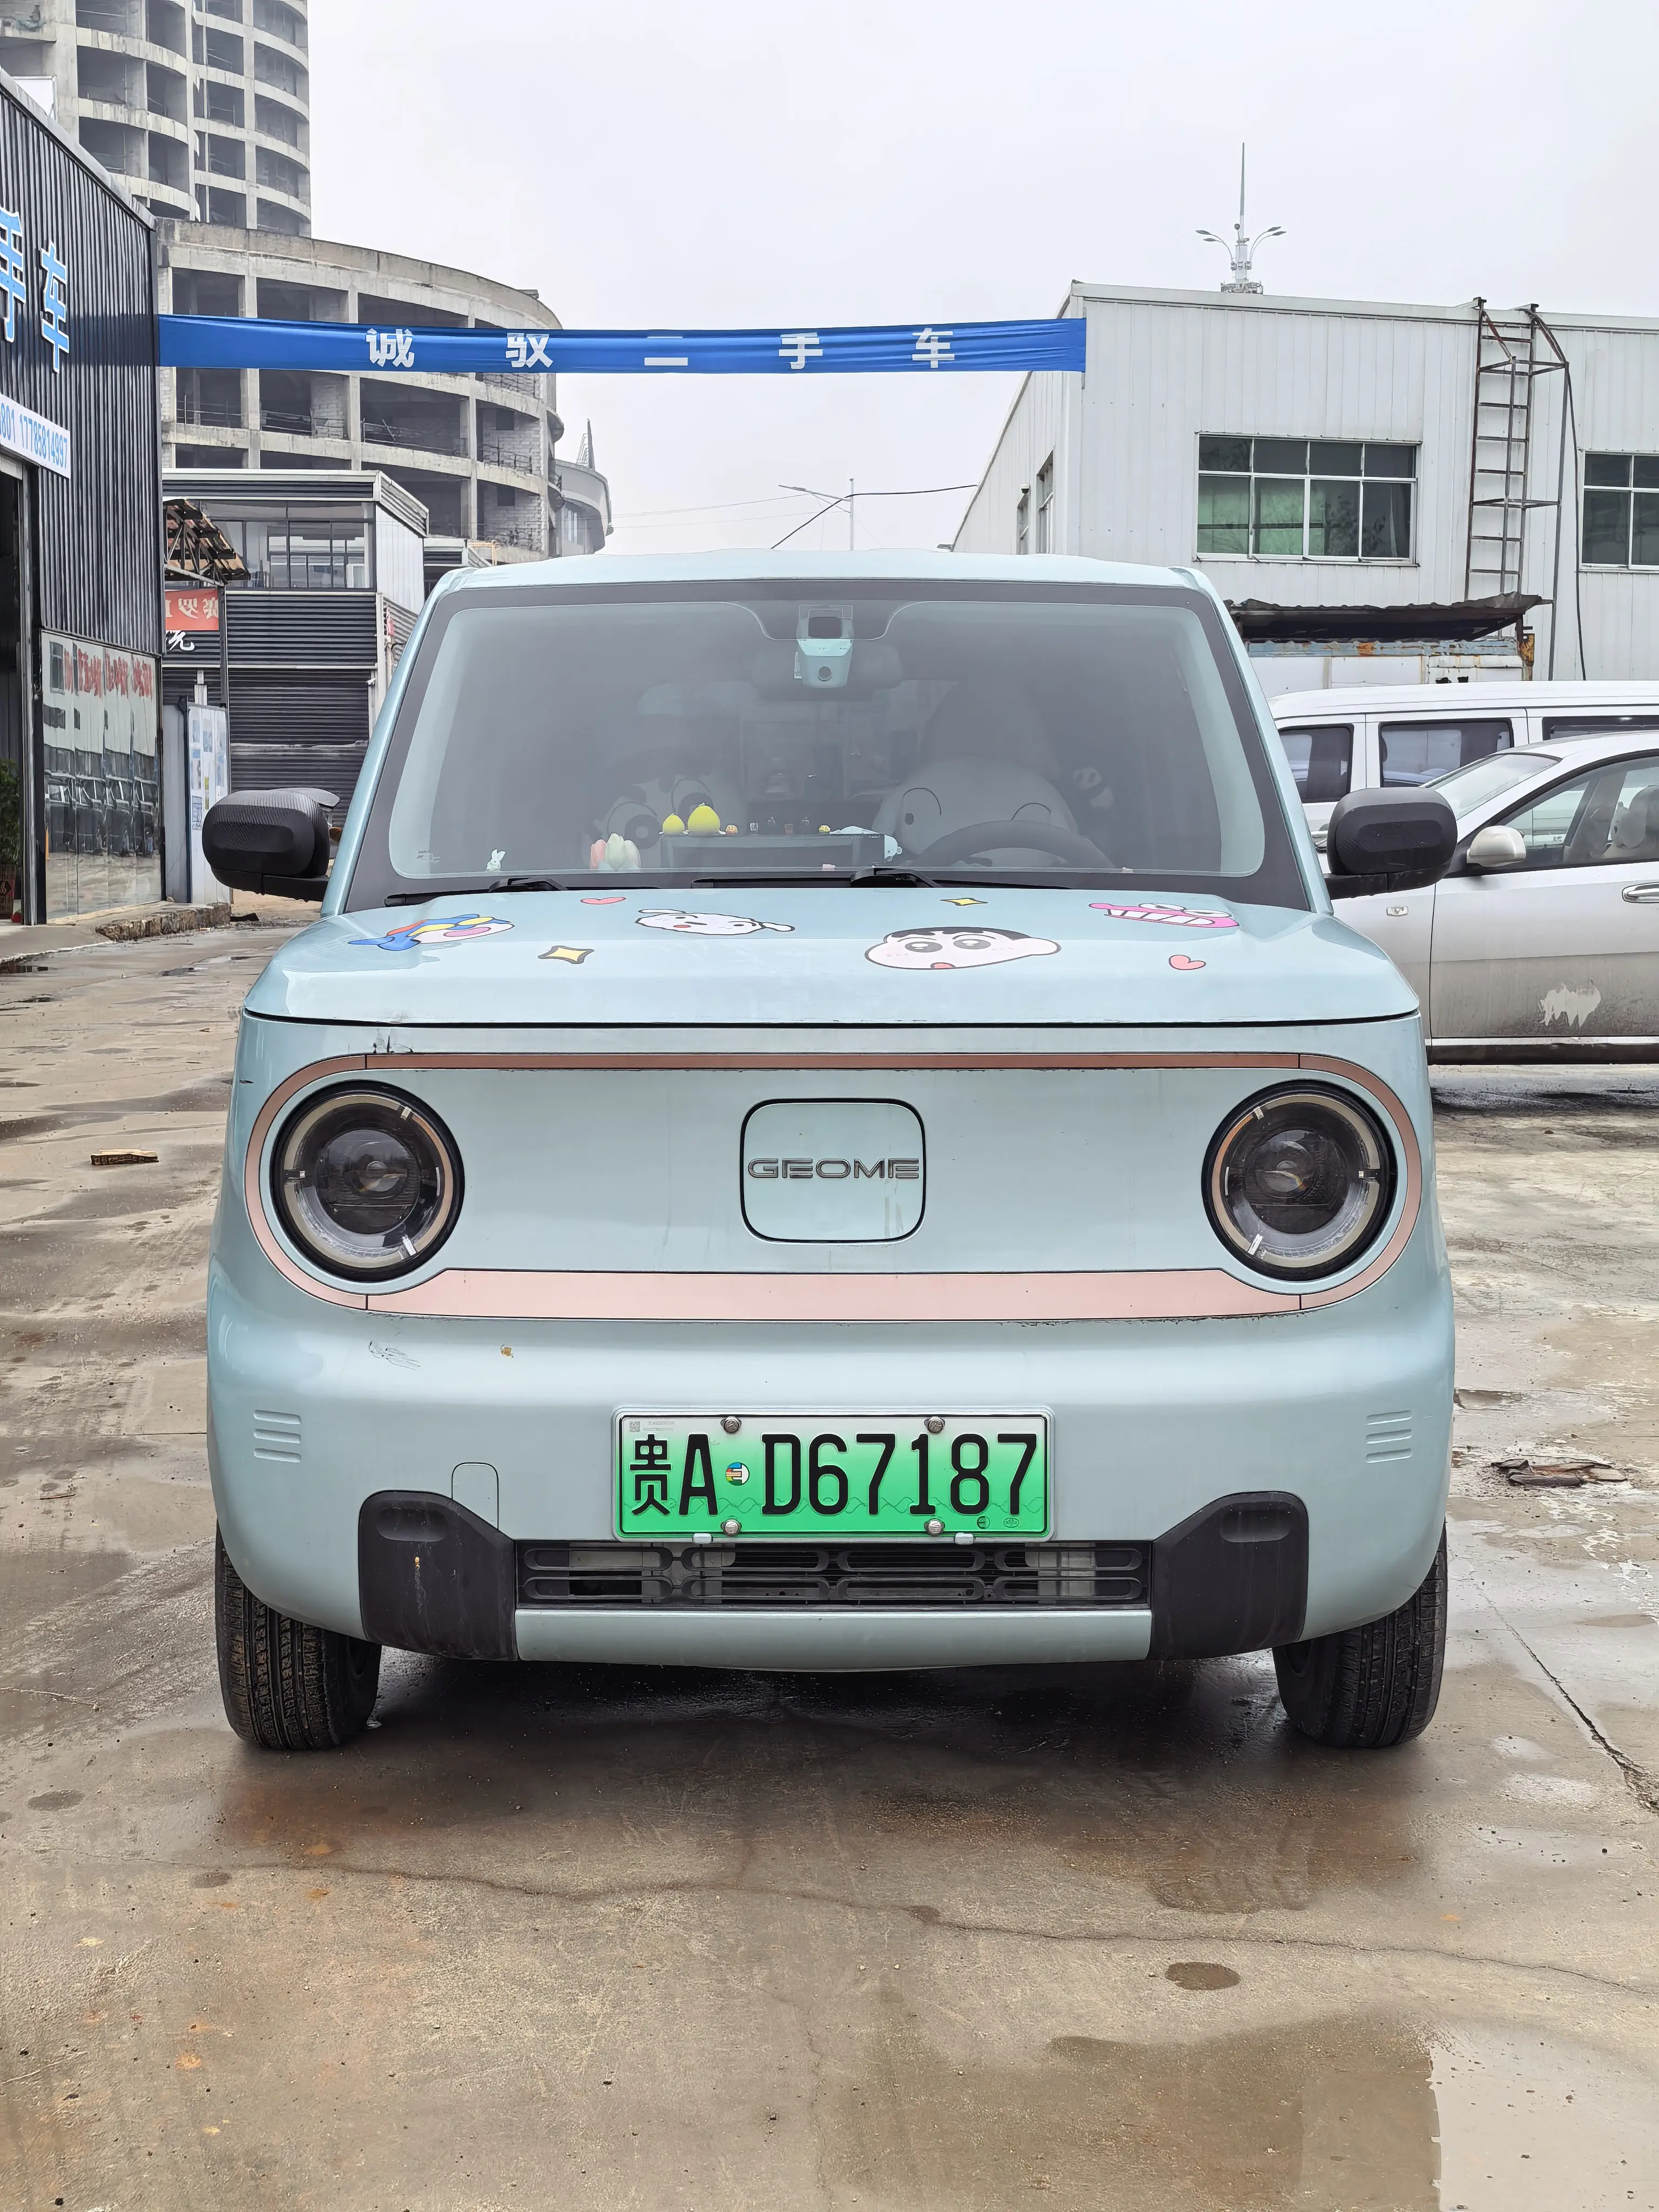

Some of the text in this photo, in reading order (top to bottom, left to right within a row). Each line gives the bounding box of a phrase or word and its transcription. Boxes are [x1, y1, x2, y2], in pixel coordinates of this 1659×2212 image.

[366, 327, 955, 368] 诚驭二手车
[0, 402, 68, 469] 801 17785814997
[747, 1158, 920, 1179] GEOME
